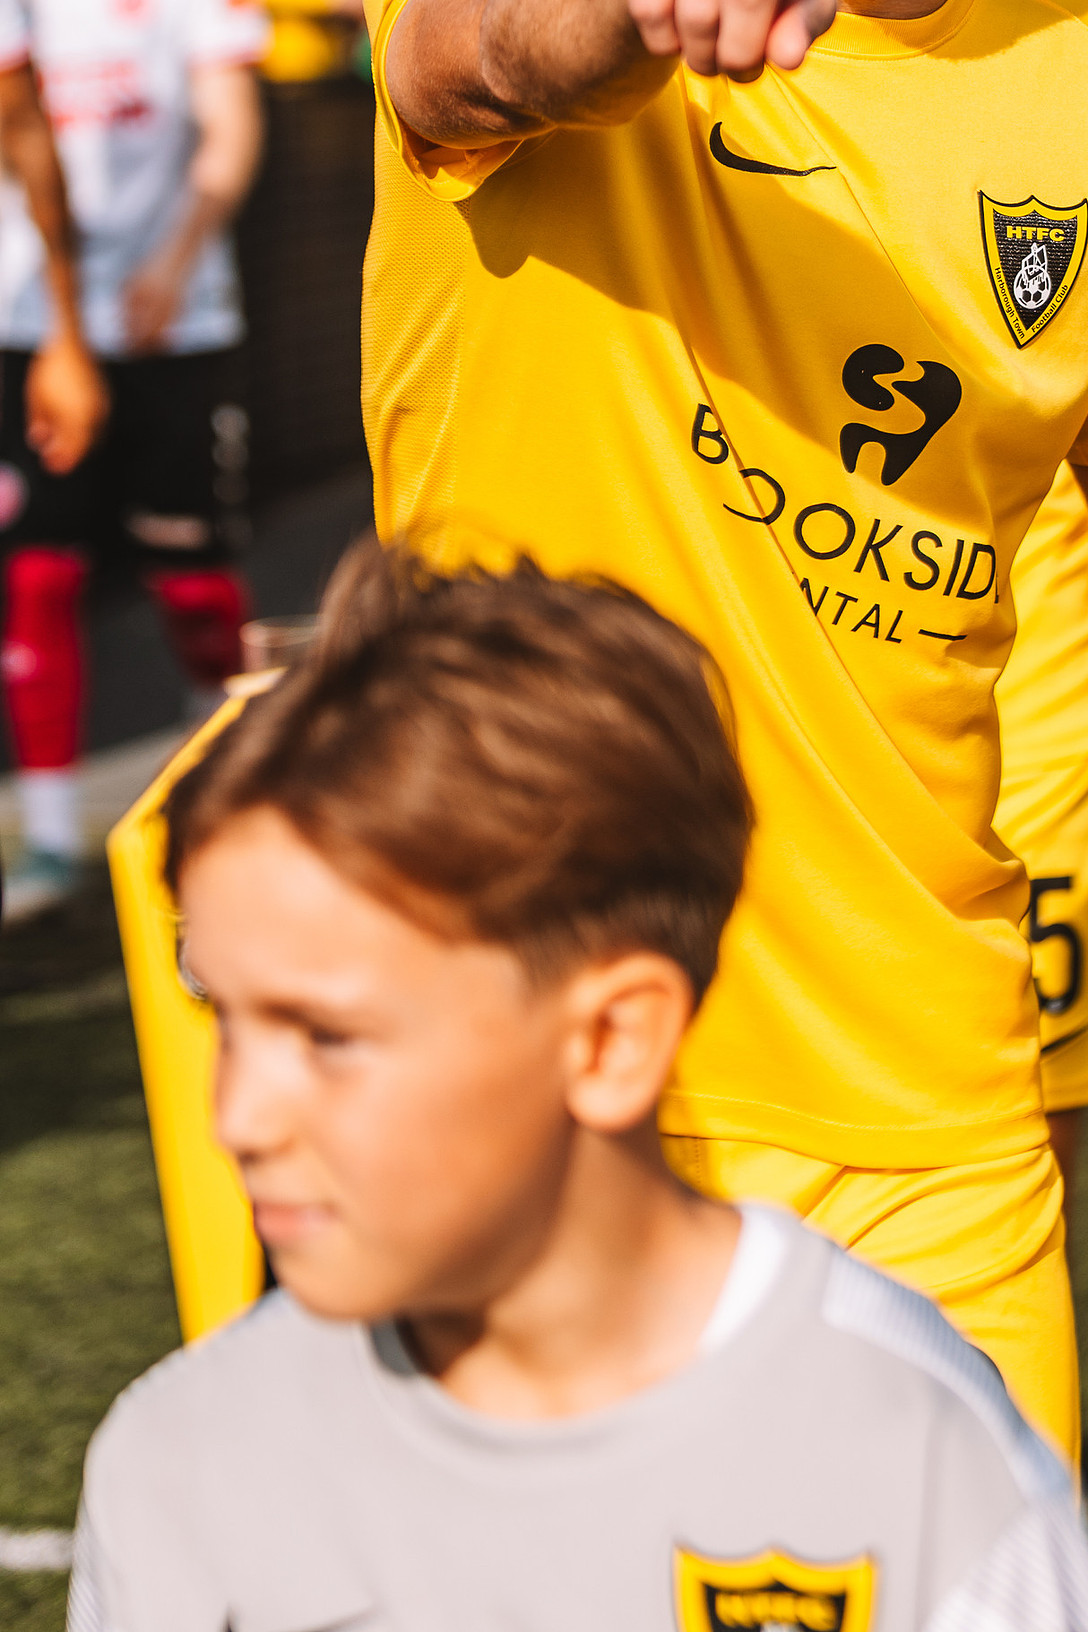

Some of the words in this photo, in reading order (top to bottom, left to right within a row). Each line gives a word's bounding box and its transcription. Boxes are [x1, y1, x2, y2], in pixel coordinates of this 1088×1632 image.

[1006, 225, 1065, 242] HTFC
[995, 267, 1015, 318] Harborough
[1012, 316, 1025, 339] Town
[1031, 303, 1057, 333] Football
[1055, 284, 1068, 304] Club
[691, 402, 1000, 604] BOOKSID
